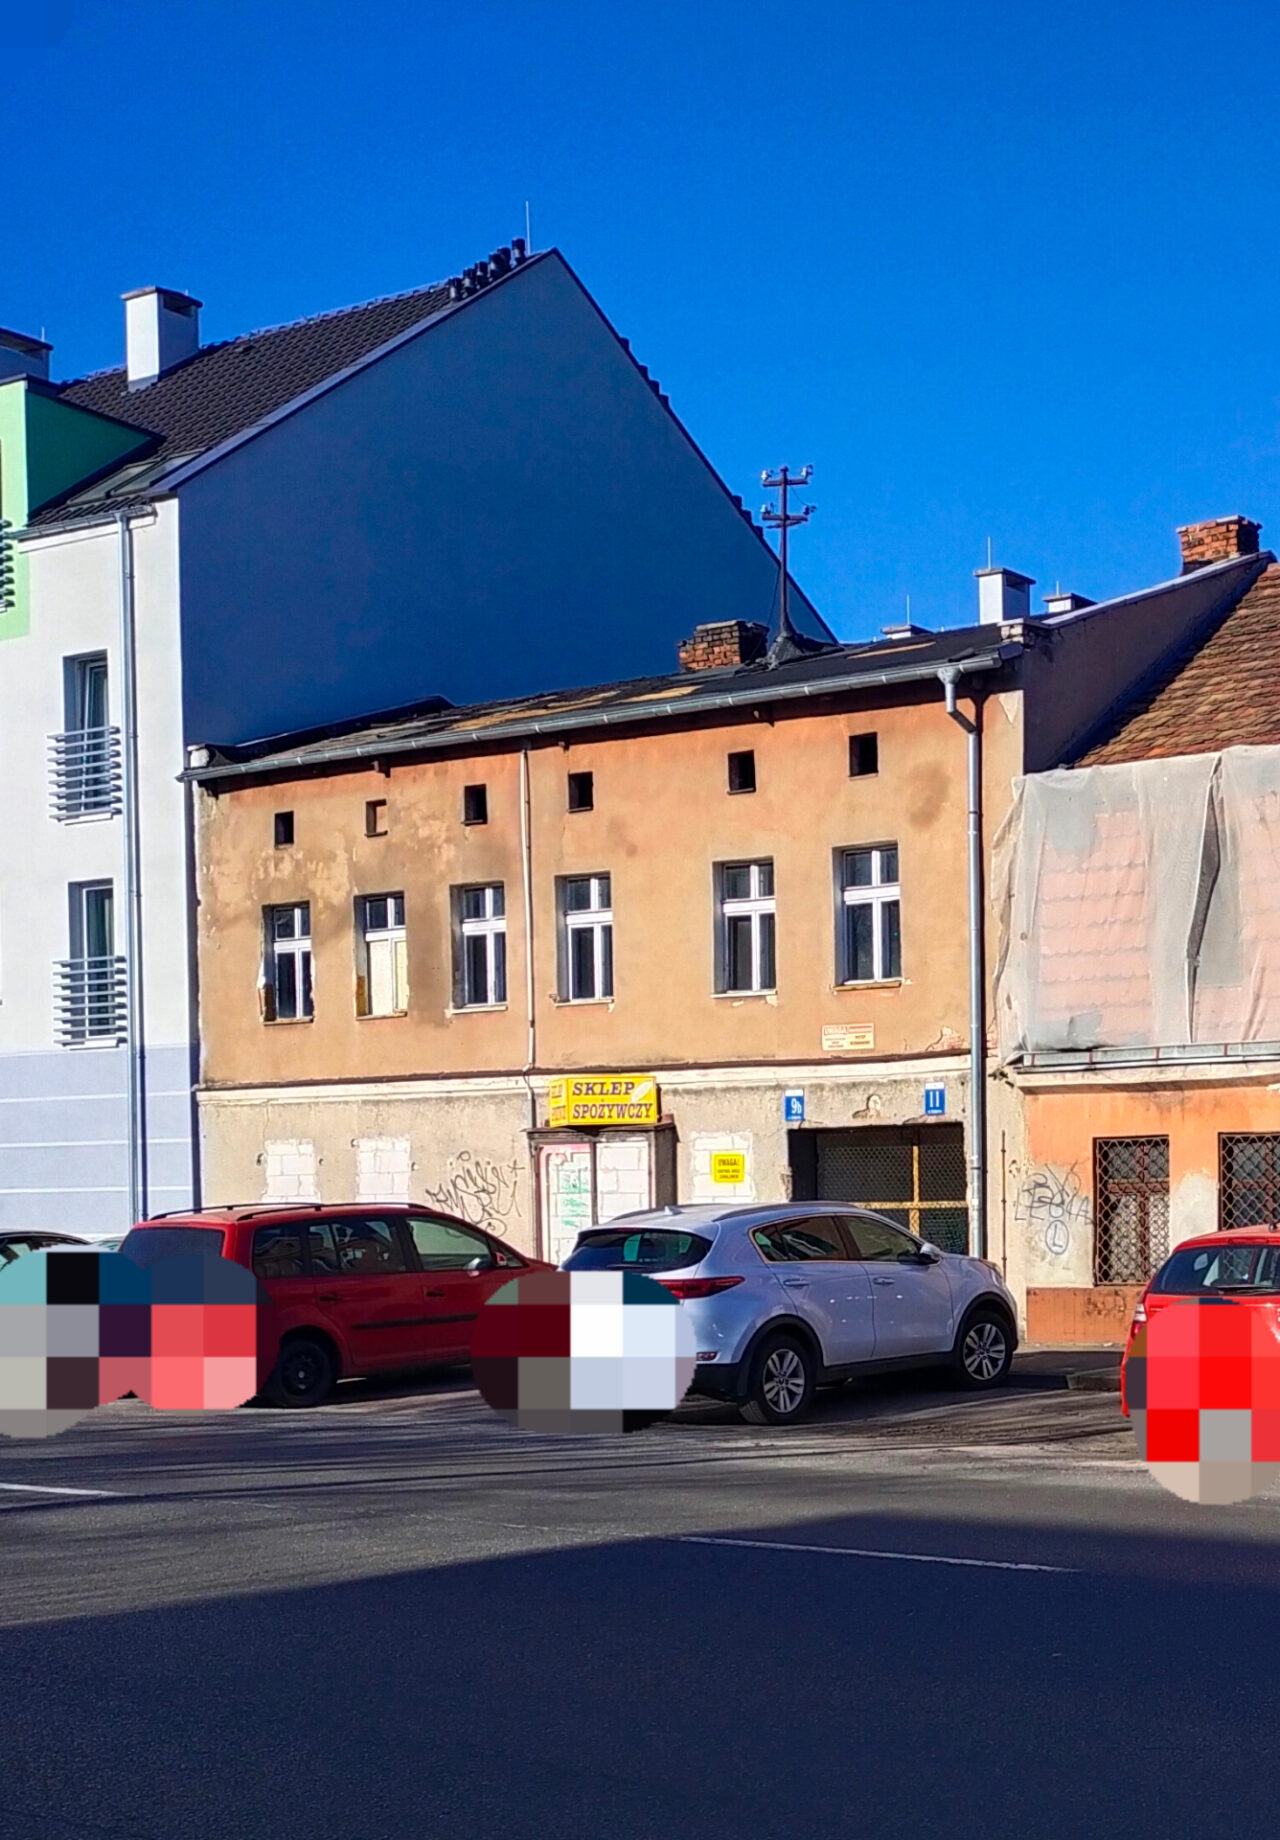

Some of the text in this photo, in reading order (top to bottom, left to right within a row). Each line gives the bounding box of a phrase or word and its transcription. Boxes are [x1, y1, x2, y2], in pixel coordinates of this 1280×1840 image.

[572, 1082, 635, 1096] SKLEP
[929, 1091, 940, 1107] 11
[572, 1098, 653, 1119] SPOŻYWCZY
